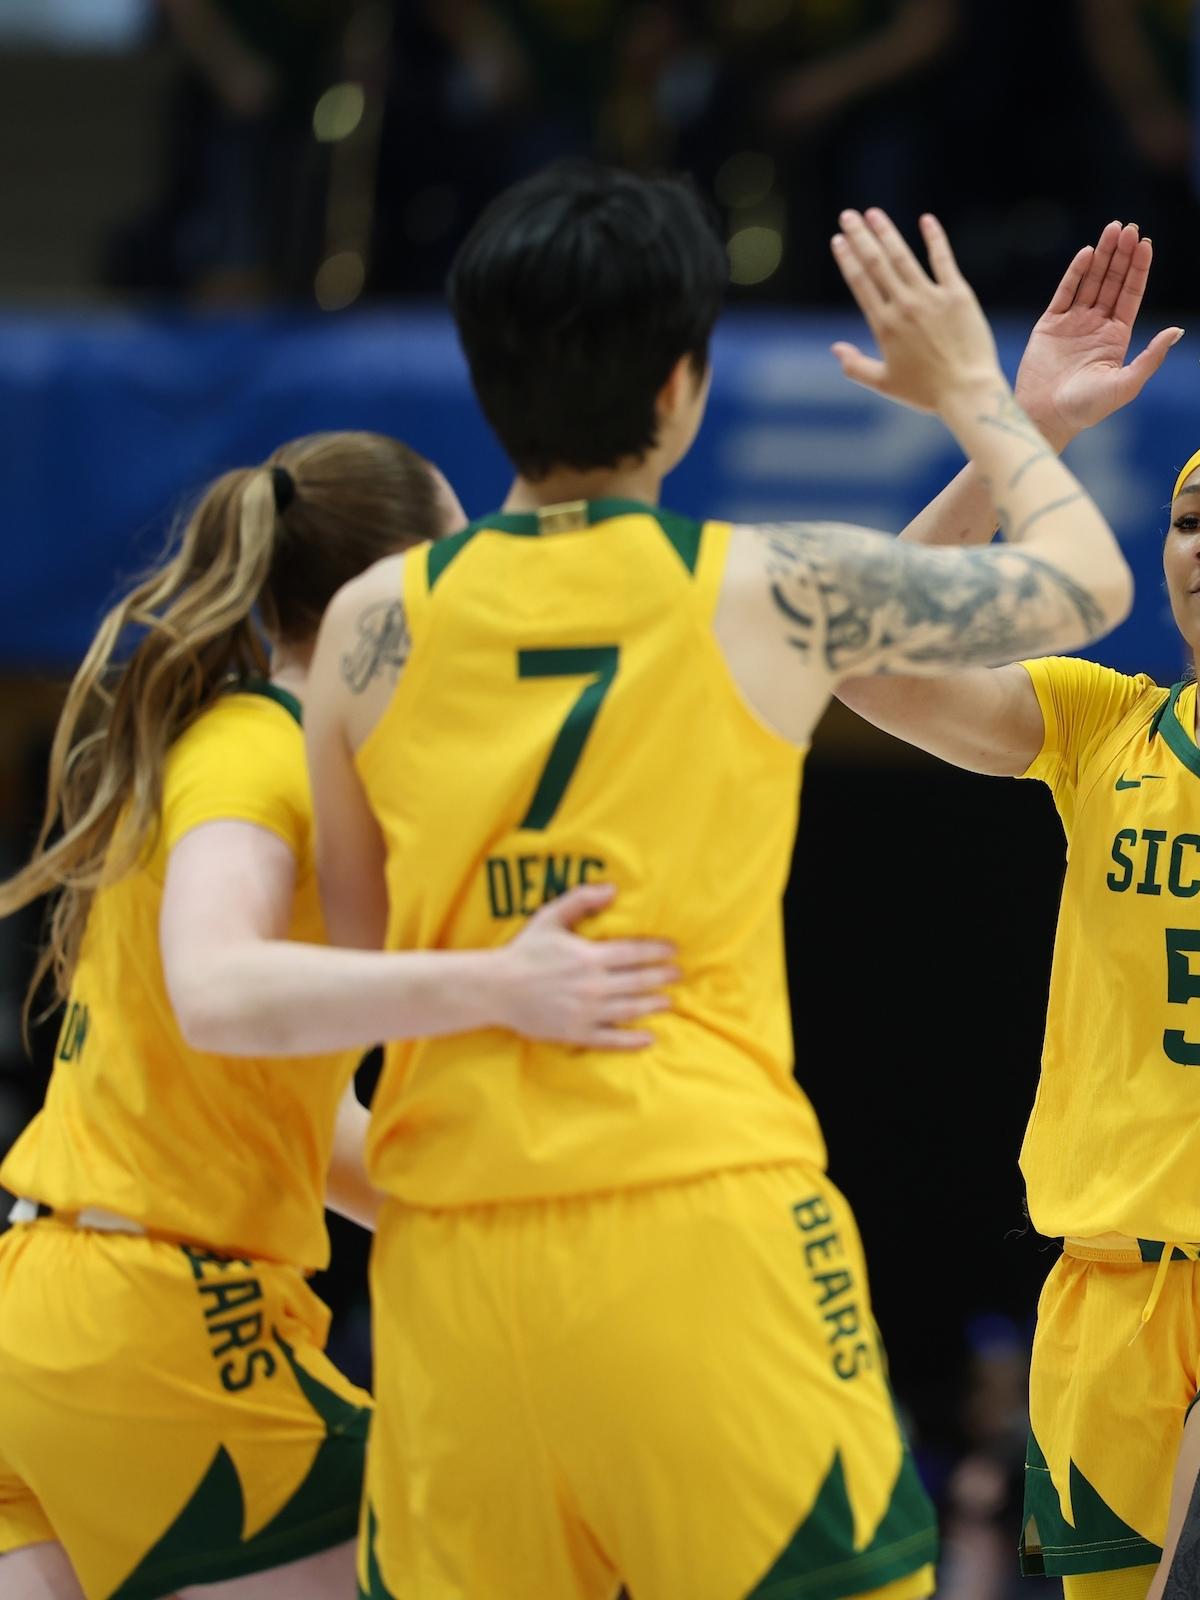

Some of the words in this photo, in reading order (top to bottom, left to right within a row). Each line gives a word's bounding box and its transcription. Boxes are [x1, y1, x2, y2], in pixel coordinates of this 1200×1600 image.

[517, 645, 621, 832] 7
[180, 1243, 277, 1392] EARS
[792, 1196, 871, 1381] BEARS
